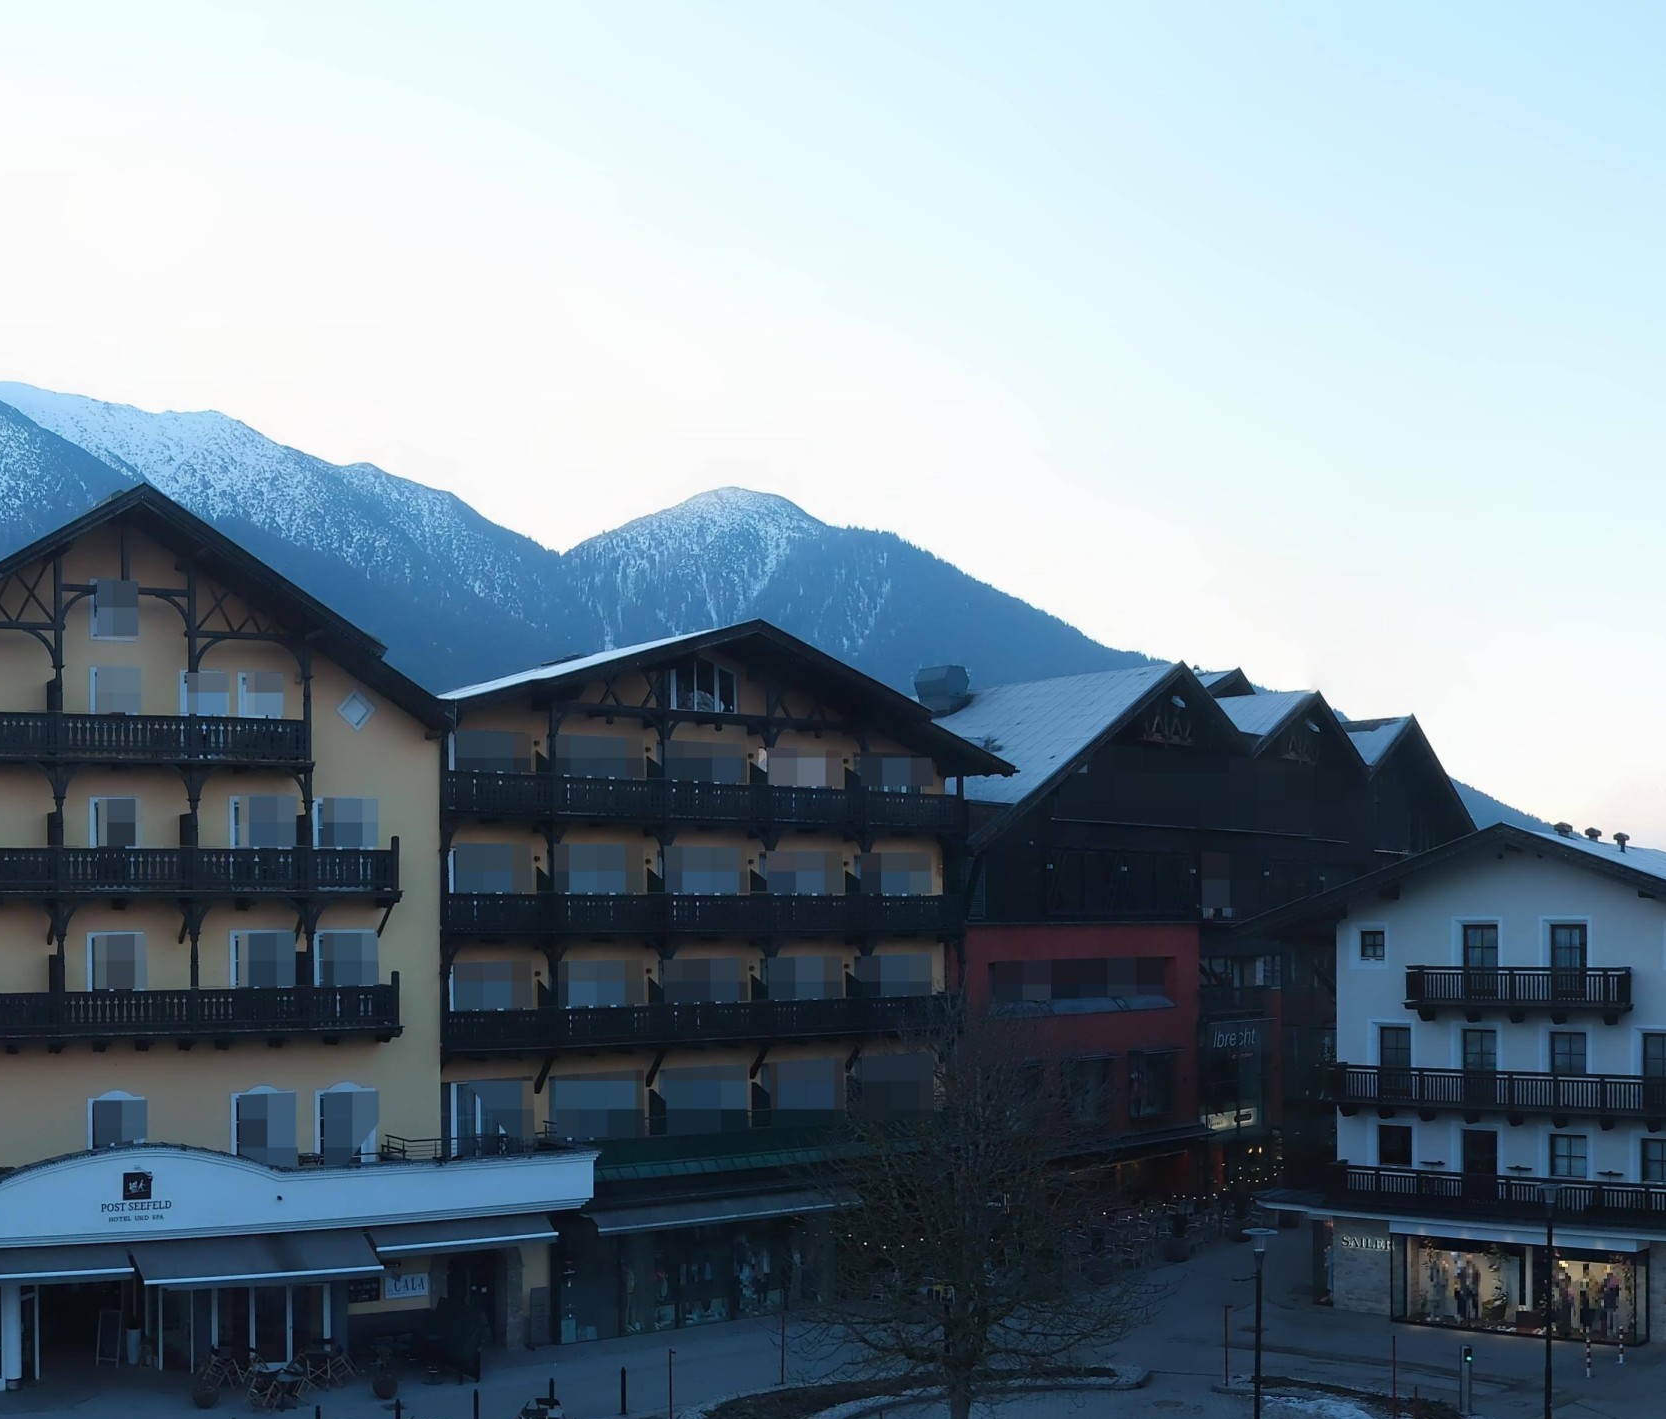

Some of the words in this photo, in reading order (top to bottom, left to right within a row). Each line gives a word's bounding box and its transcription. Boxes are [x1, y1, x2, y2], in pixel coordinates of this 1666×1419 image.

[100, 1202, 126, 1213] POST
[128, 1200, 172, 1211] SEEFELD
[108, 1215, 132, 1223] HOTEL
[1341, 1235, 1395, 1250] SAILER
